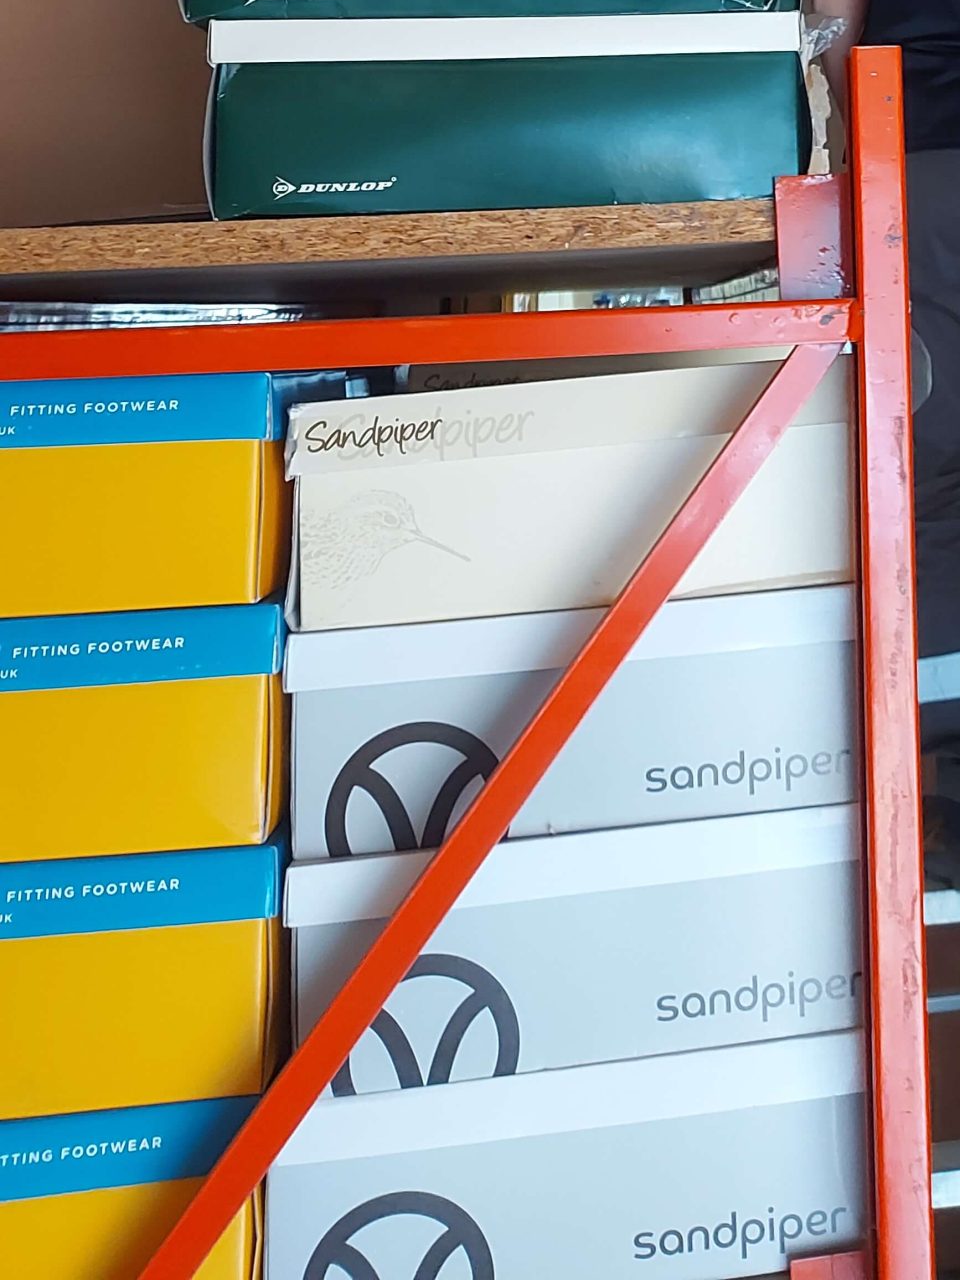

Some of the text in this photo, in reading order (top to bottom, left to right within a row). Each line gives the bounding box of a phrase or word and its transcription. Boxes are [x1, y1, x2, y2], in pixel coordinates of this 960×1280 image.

[297, 181, 393, 193] DUNLOP
[10, 399, 180, 416] FITTING FOOTWEAR
[304, 416, 443, 457] Sandpiper
[12, 637, 185, 659] FITTING FOOTWEAR
[0, 669, 18, 679] UK
[645, 747, 850, 796] sandpiper
[6, 878, 180, 903] FITTING FOOTWEAR
[656, 970, 862, 1022] sandpiper
[0, 1136, 162, 1167] TTING FOOTWEAR
[633, 1206, 847, 1259] sandpiper
